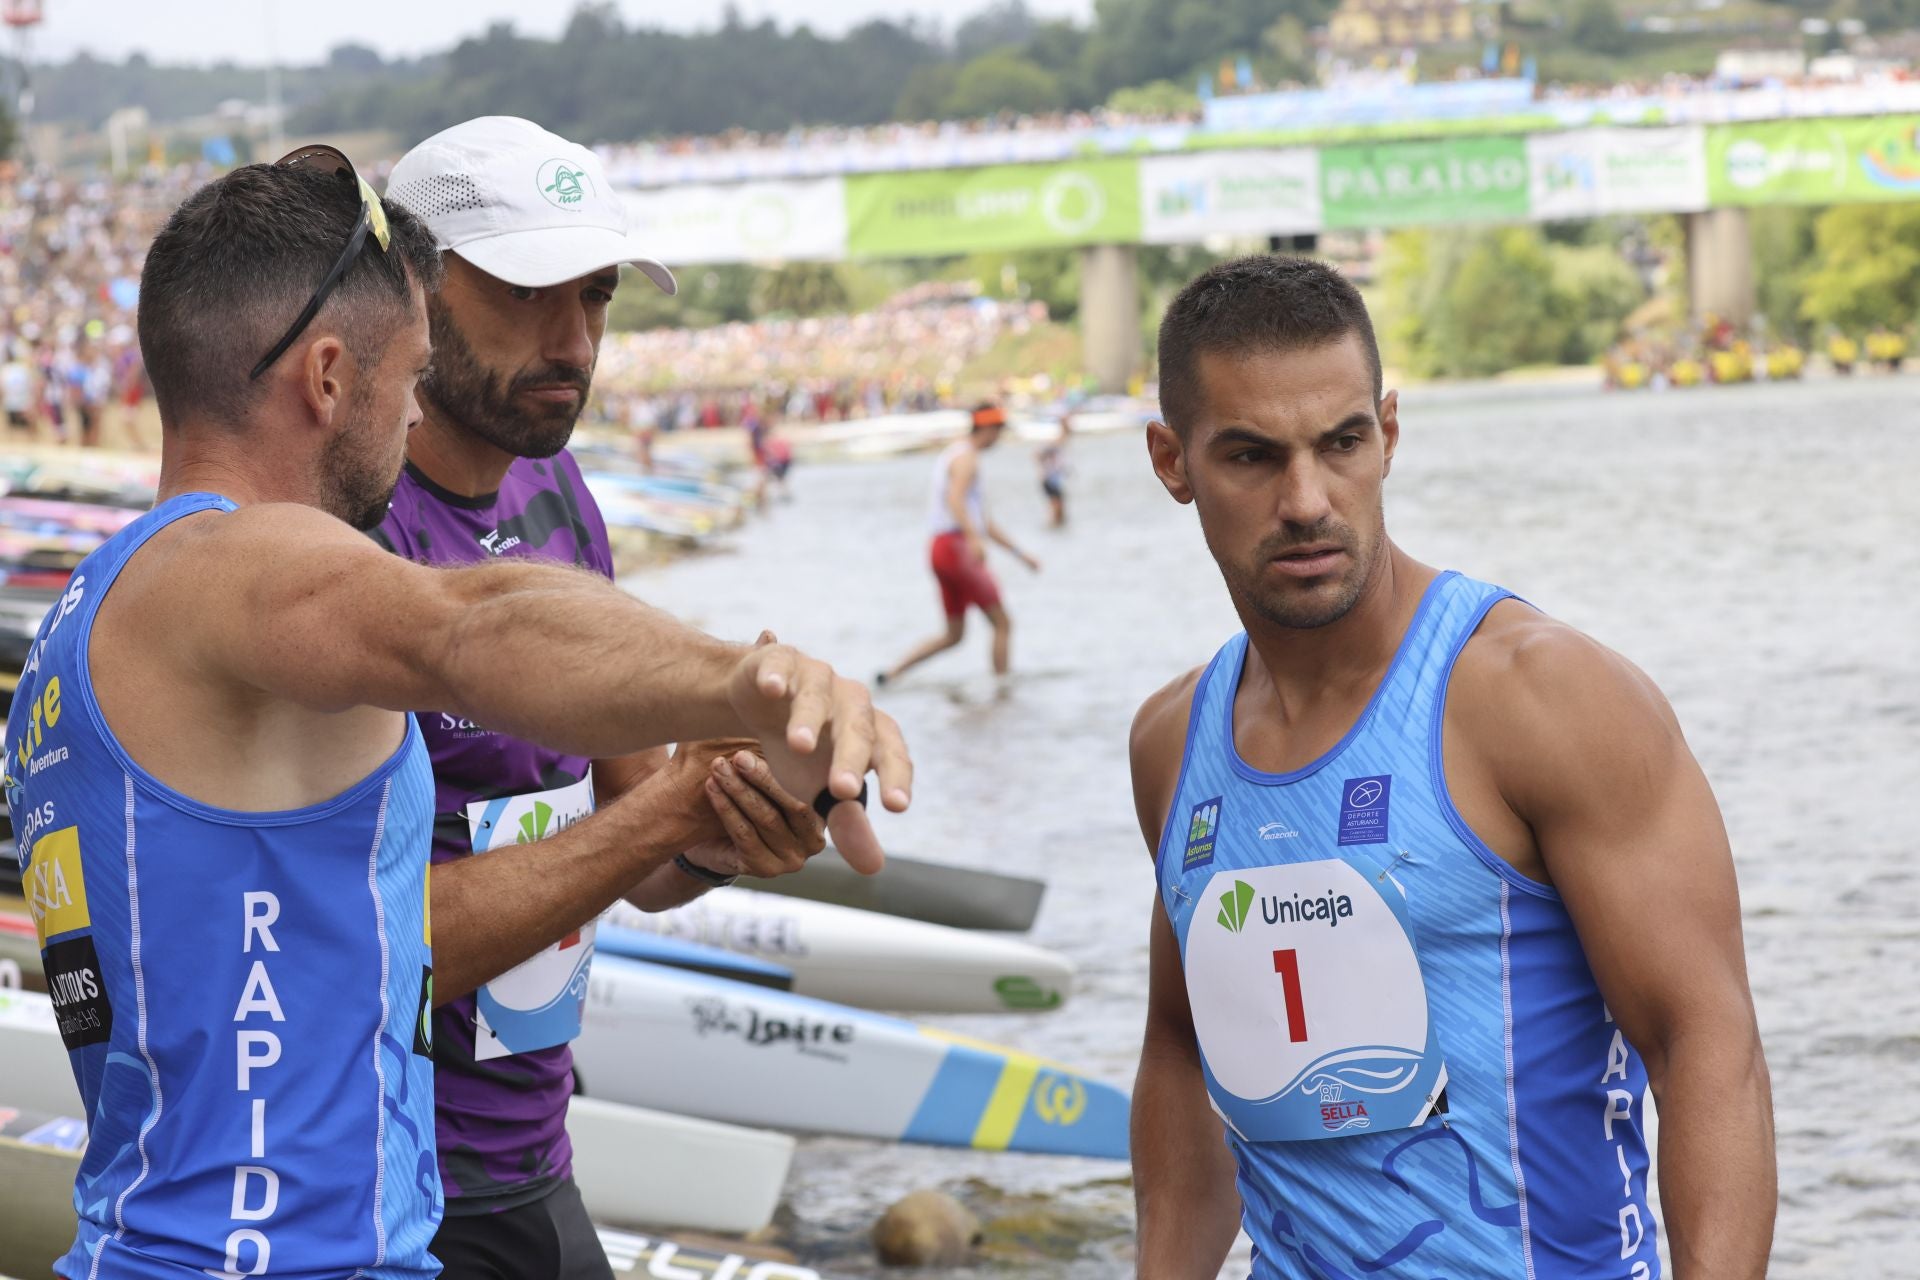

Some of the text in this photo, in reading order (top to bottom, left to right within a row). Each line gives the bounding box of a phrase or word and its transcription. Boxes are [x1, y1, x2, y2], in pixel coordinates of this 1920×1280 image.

[29, 745, 69, 777] Aventura
[1347, 811, 1379, 820] DEPORTE
[1261, 889, 1353, 928] Unicaja
[1272, 948, 1308, 1043] 1
[1319, 1083, 1342, 1102] 87
[1320, 1103, 1368, 1121] SELLA
